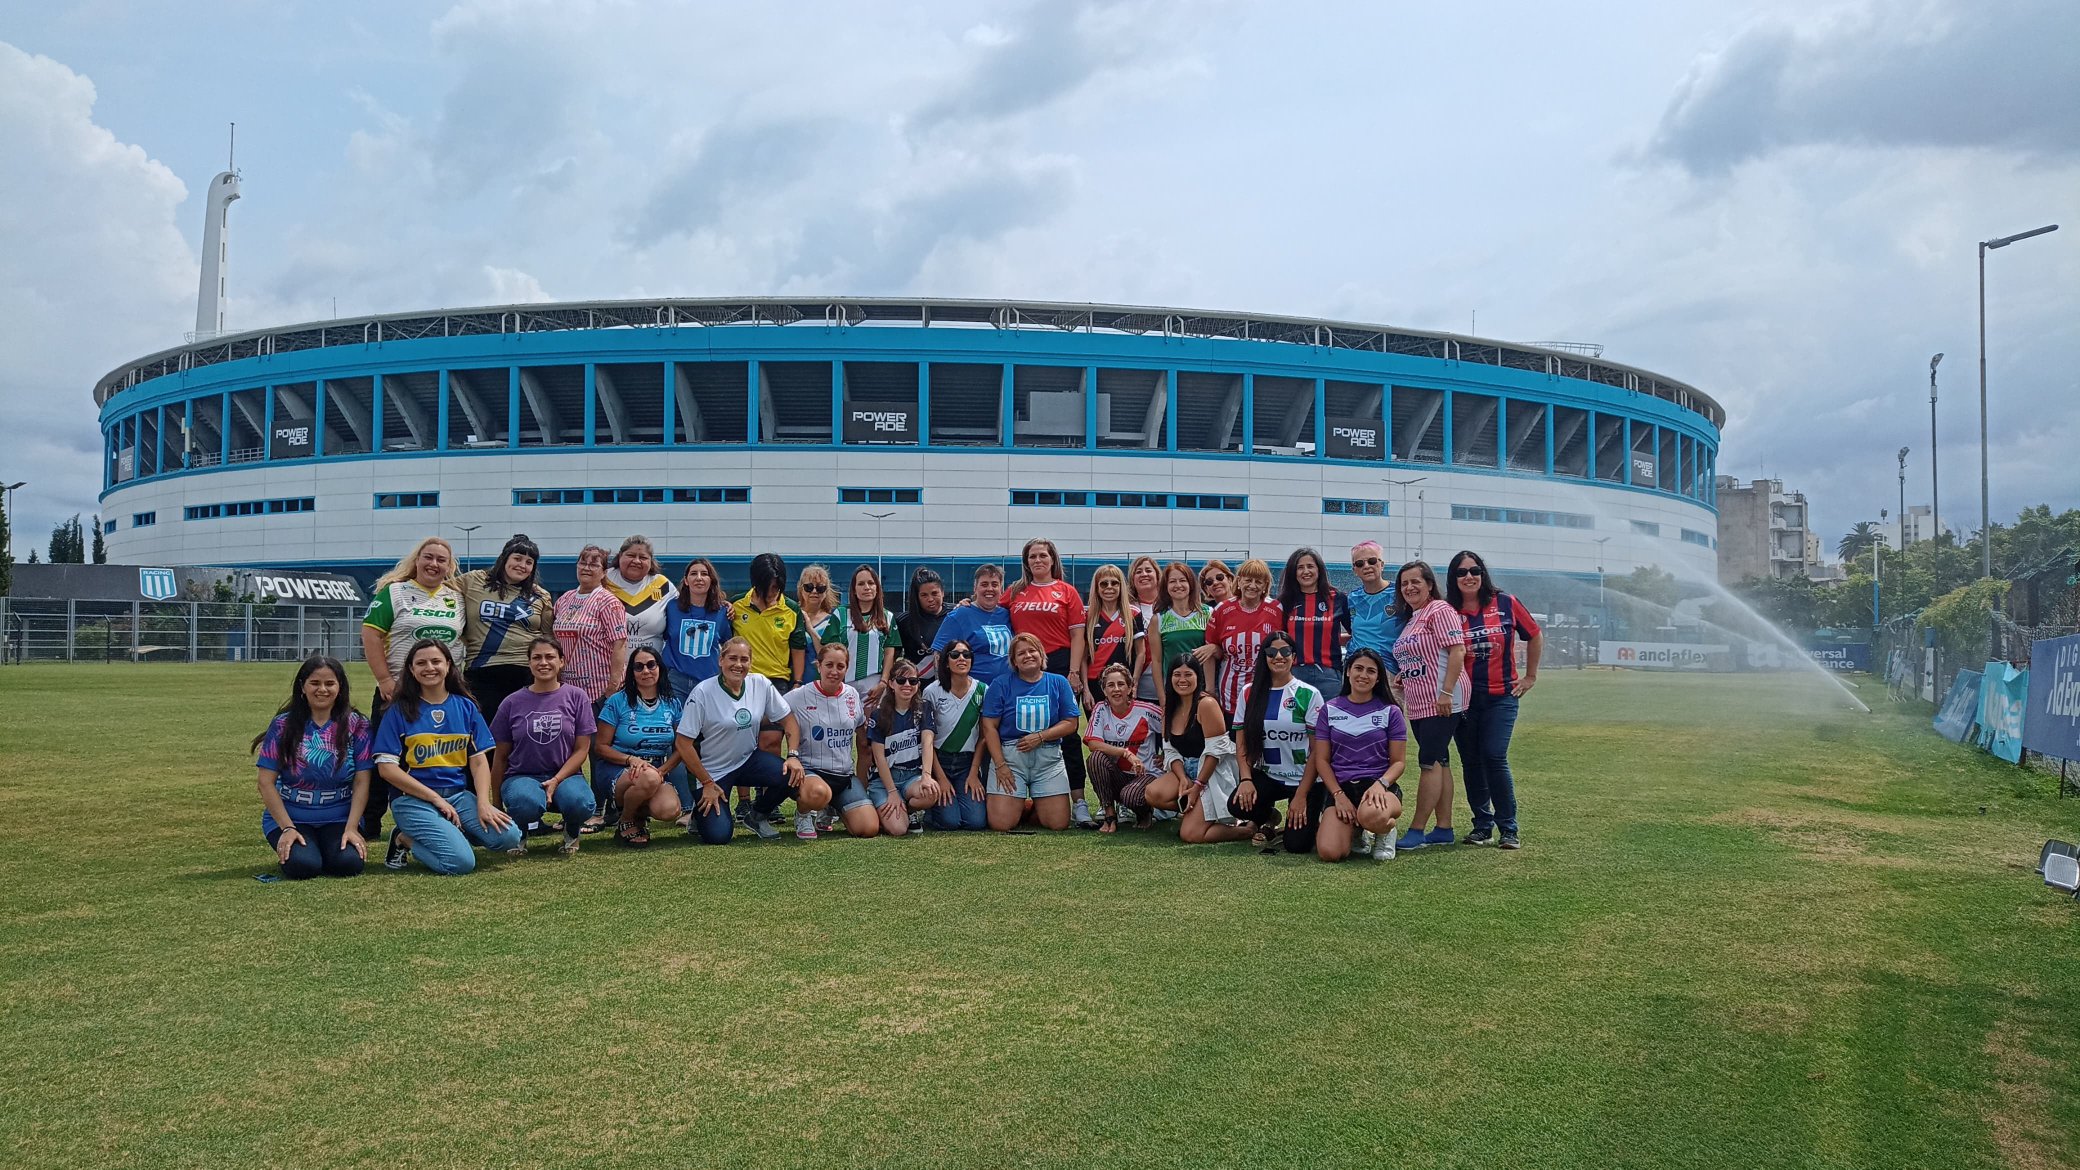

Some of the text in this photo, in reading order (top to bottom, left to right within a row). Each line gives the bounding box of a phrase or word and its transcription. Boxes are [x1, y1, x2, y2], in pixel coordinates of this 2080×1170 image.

[852, 411, 907, 422] POWER
[276, 427, 309, 439] POWER
[1333, 427, 1376, 439] POWER
[1633, 459, 1654, 471] POWER
[254, 576, 361, 601] POWERADE
[1022, 601, 1060, 614] JELUZ
[1638, 648, 1707, 663] anclaflex
[827, 727, 854, 738] Banco
